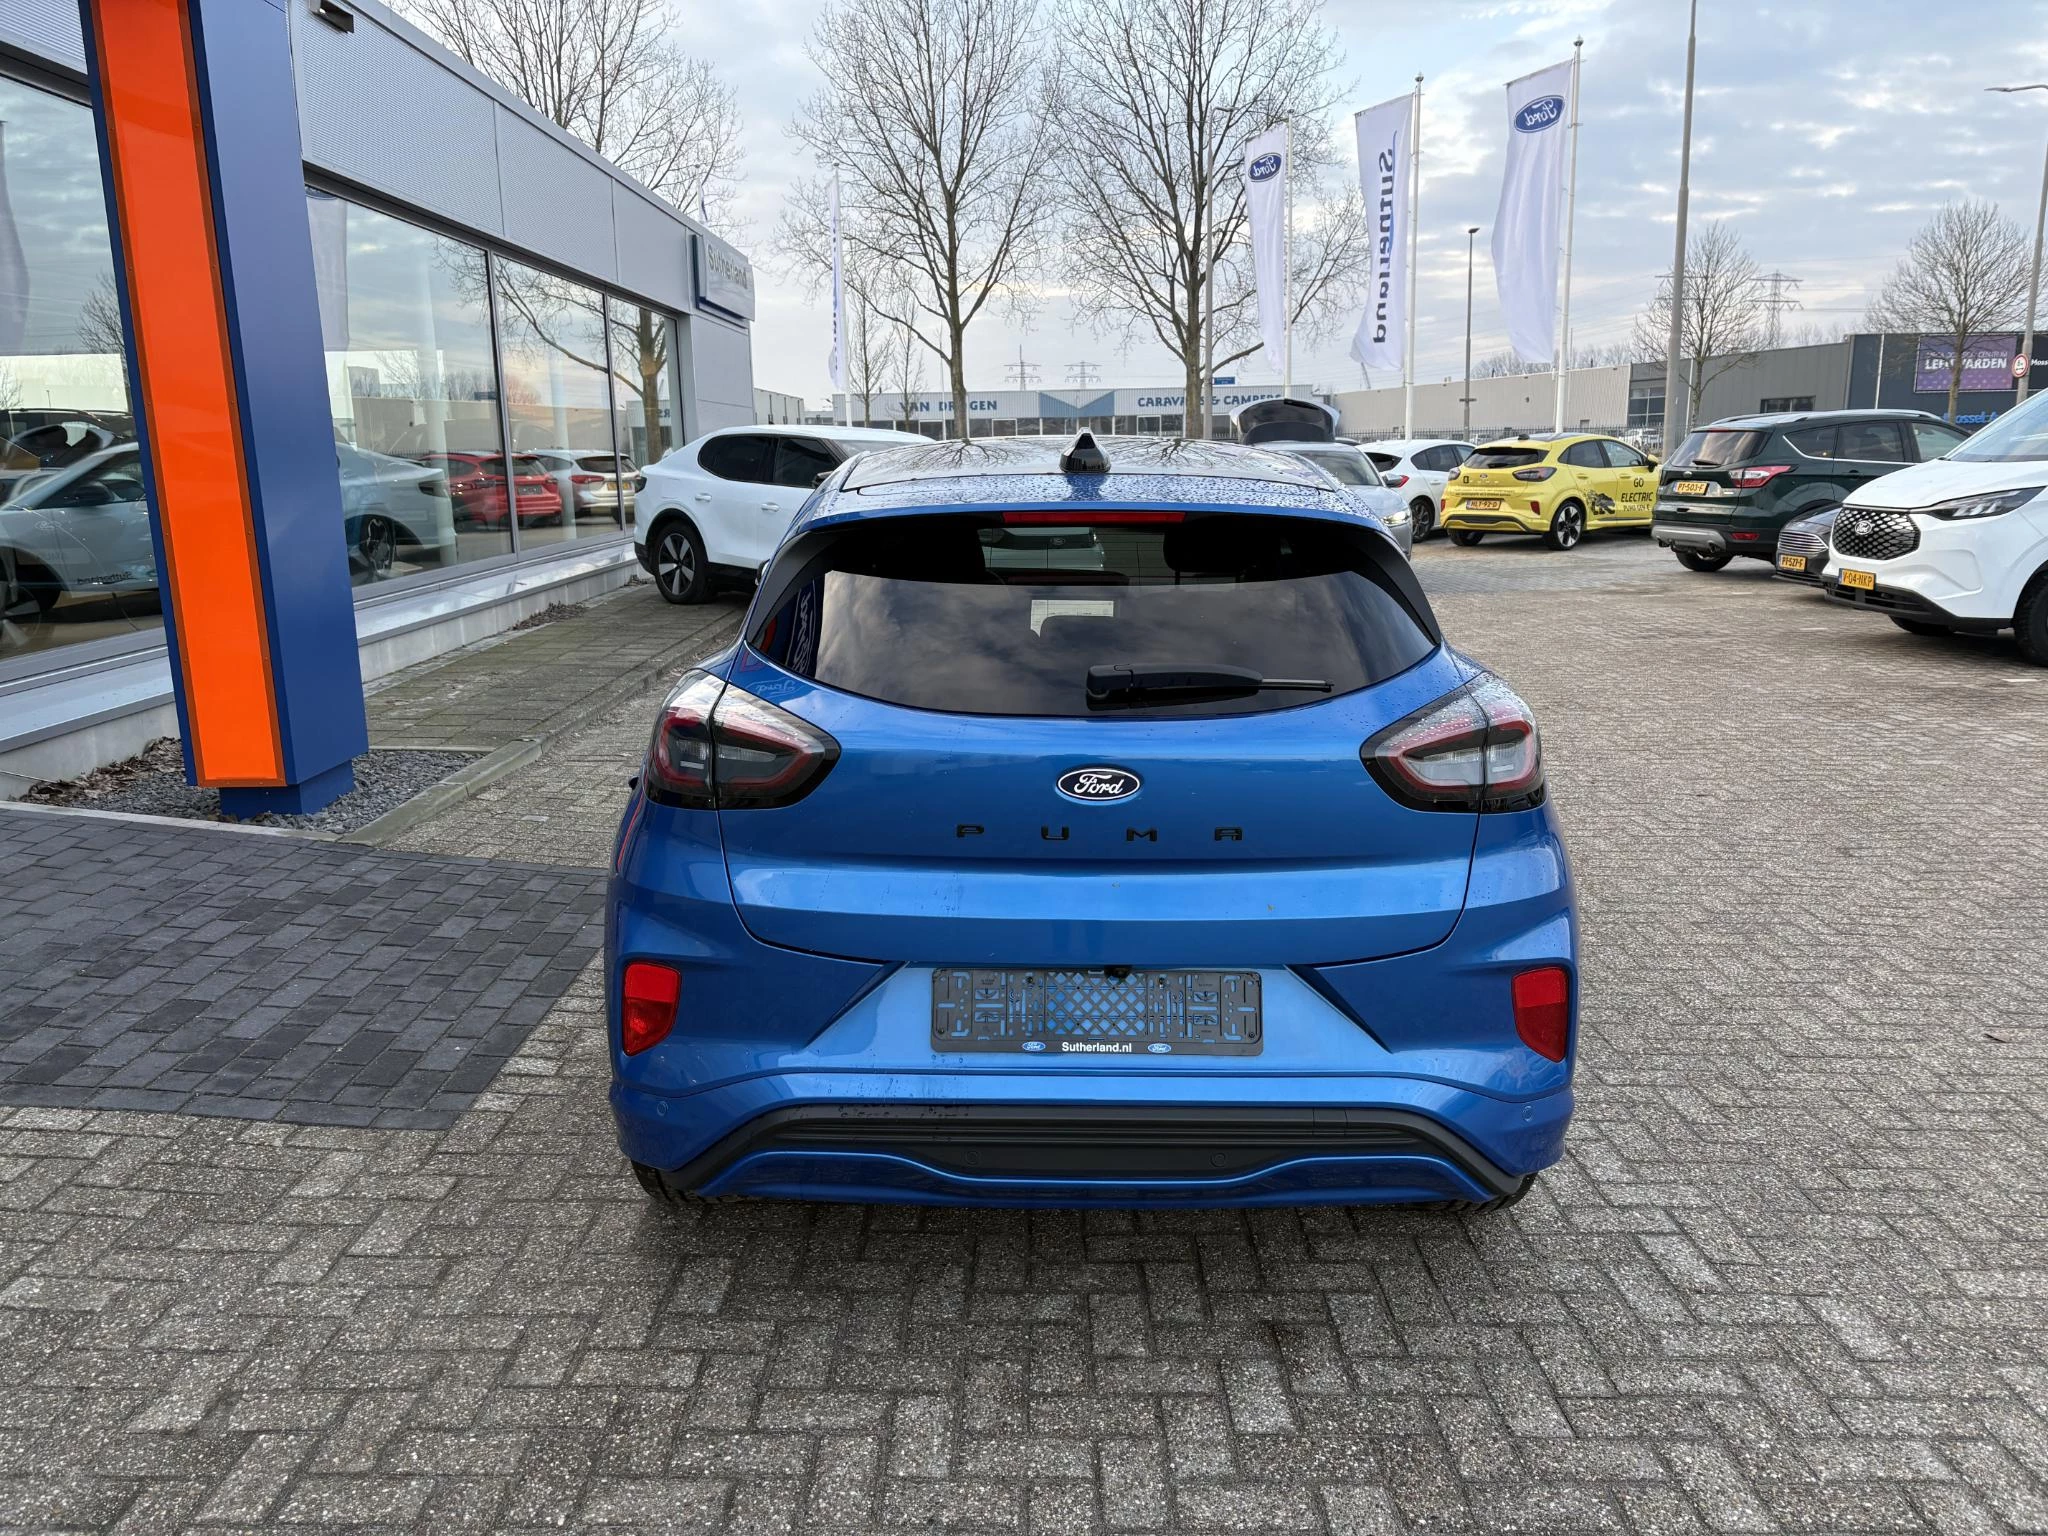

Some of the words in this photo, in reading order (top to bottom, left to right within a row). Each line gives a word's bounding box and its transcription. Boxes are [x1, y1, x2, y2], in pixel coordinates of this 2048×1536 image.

[2030, 358, 2048, 367] Moss
[938, 400, 998, 412] DRGEN
[1633, 477, 1645, 488] GO
[1621, 491, 1654, 503] ELECTRIC
[1073, 773, 1125, 795] Ford
[1062, 1041, 1132, 1053] Sutherland.nl
